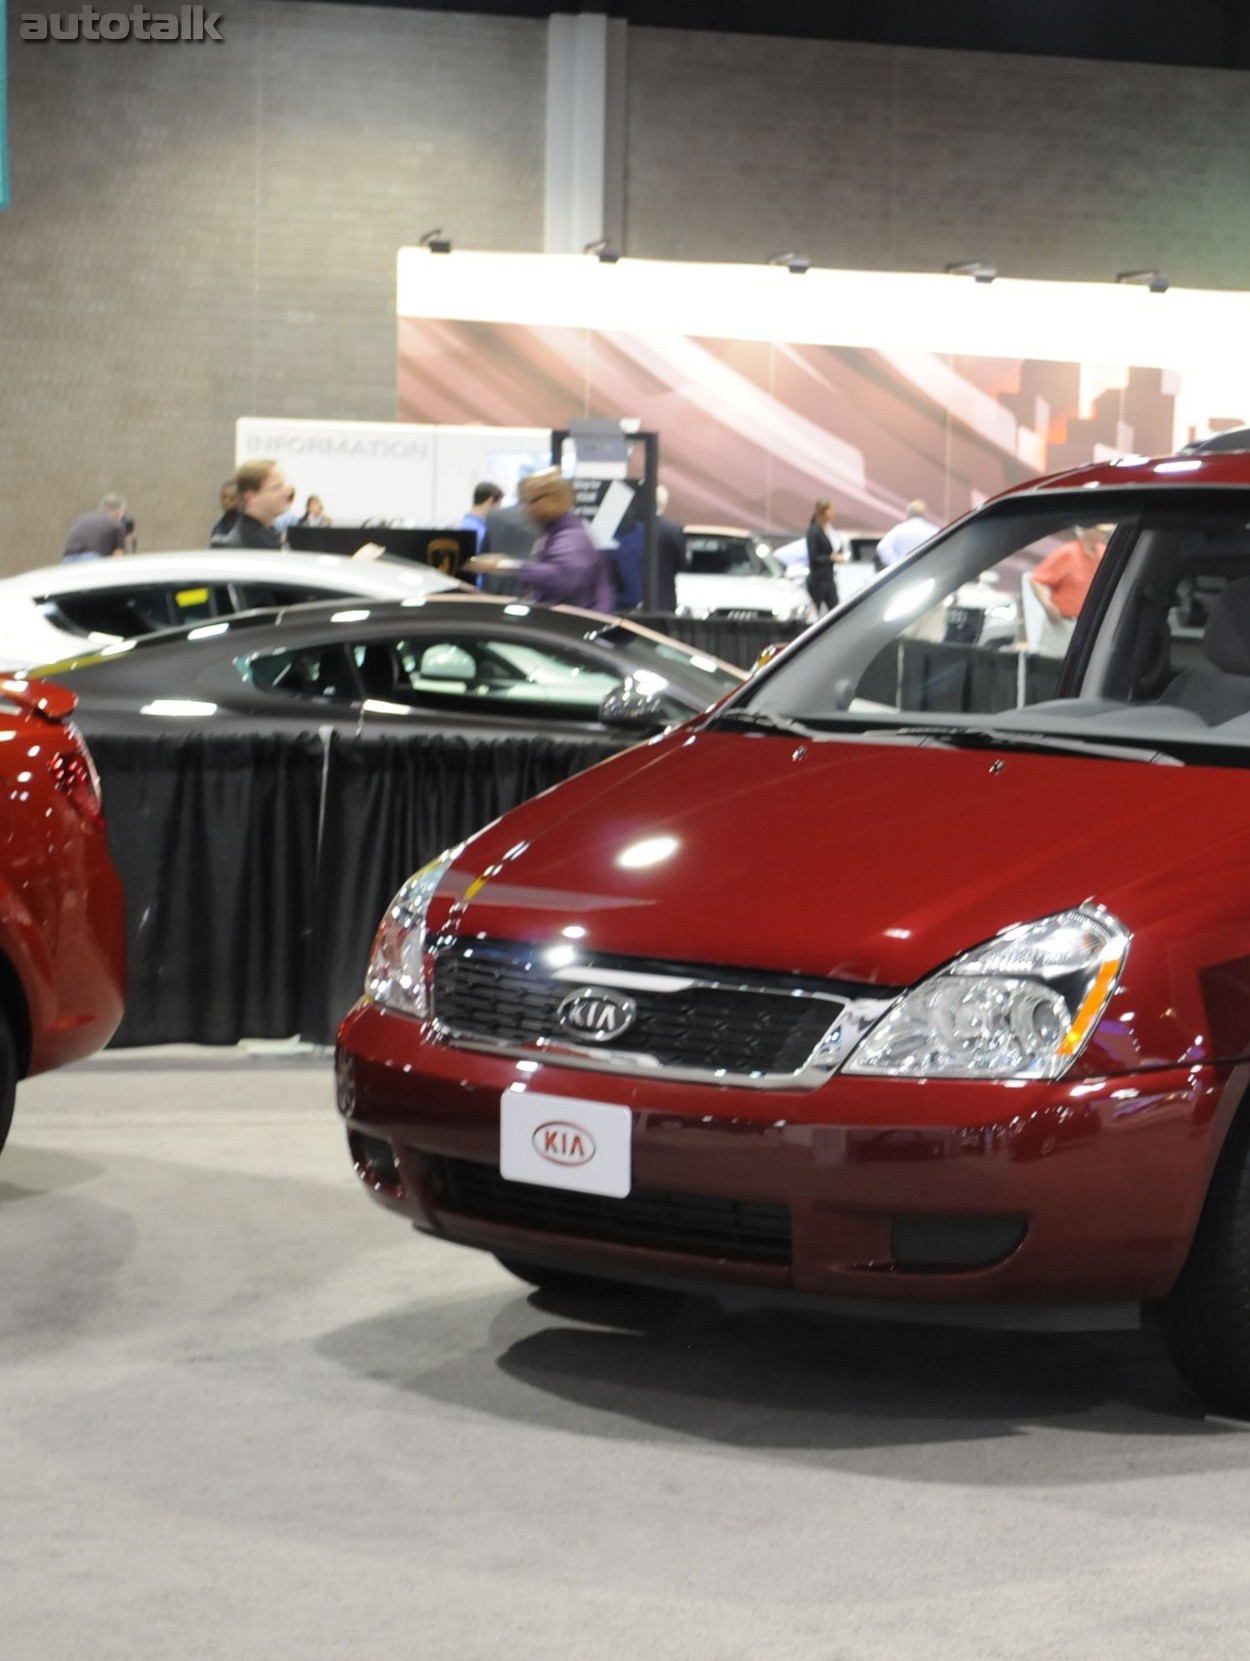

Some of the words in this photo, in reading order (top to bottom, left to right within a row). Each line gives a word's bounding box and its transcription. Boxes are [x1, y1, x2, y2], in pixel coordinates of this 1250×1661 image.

[245, 434, 428, 459] INFORMATION
[569, 1001, 616, 1031] KIA
[545, 1131, 585, 1157] KIA
